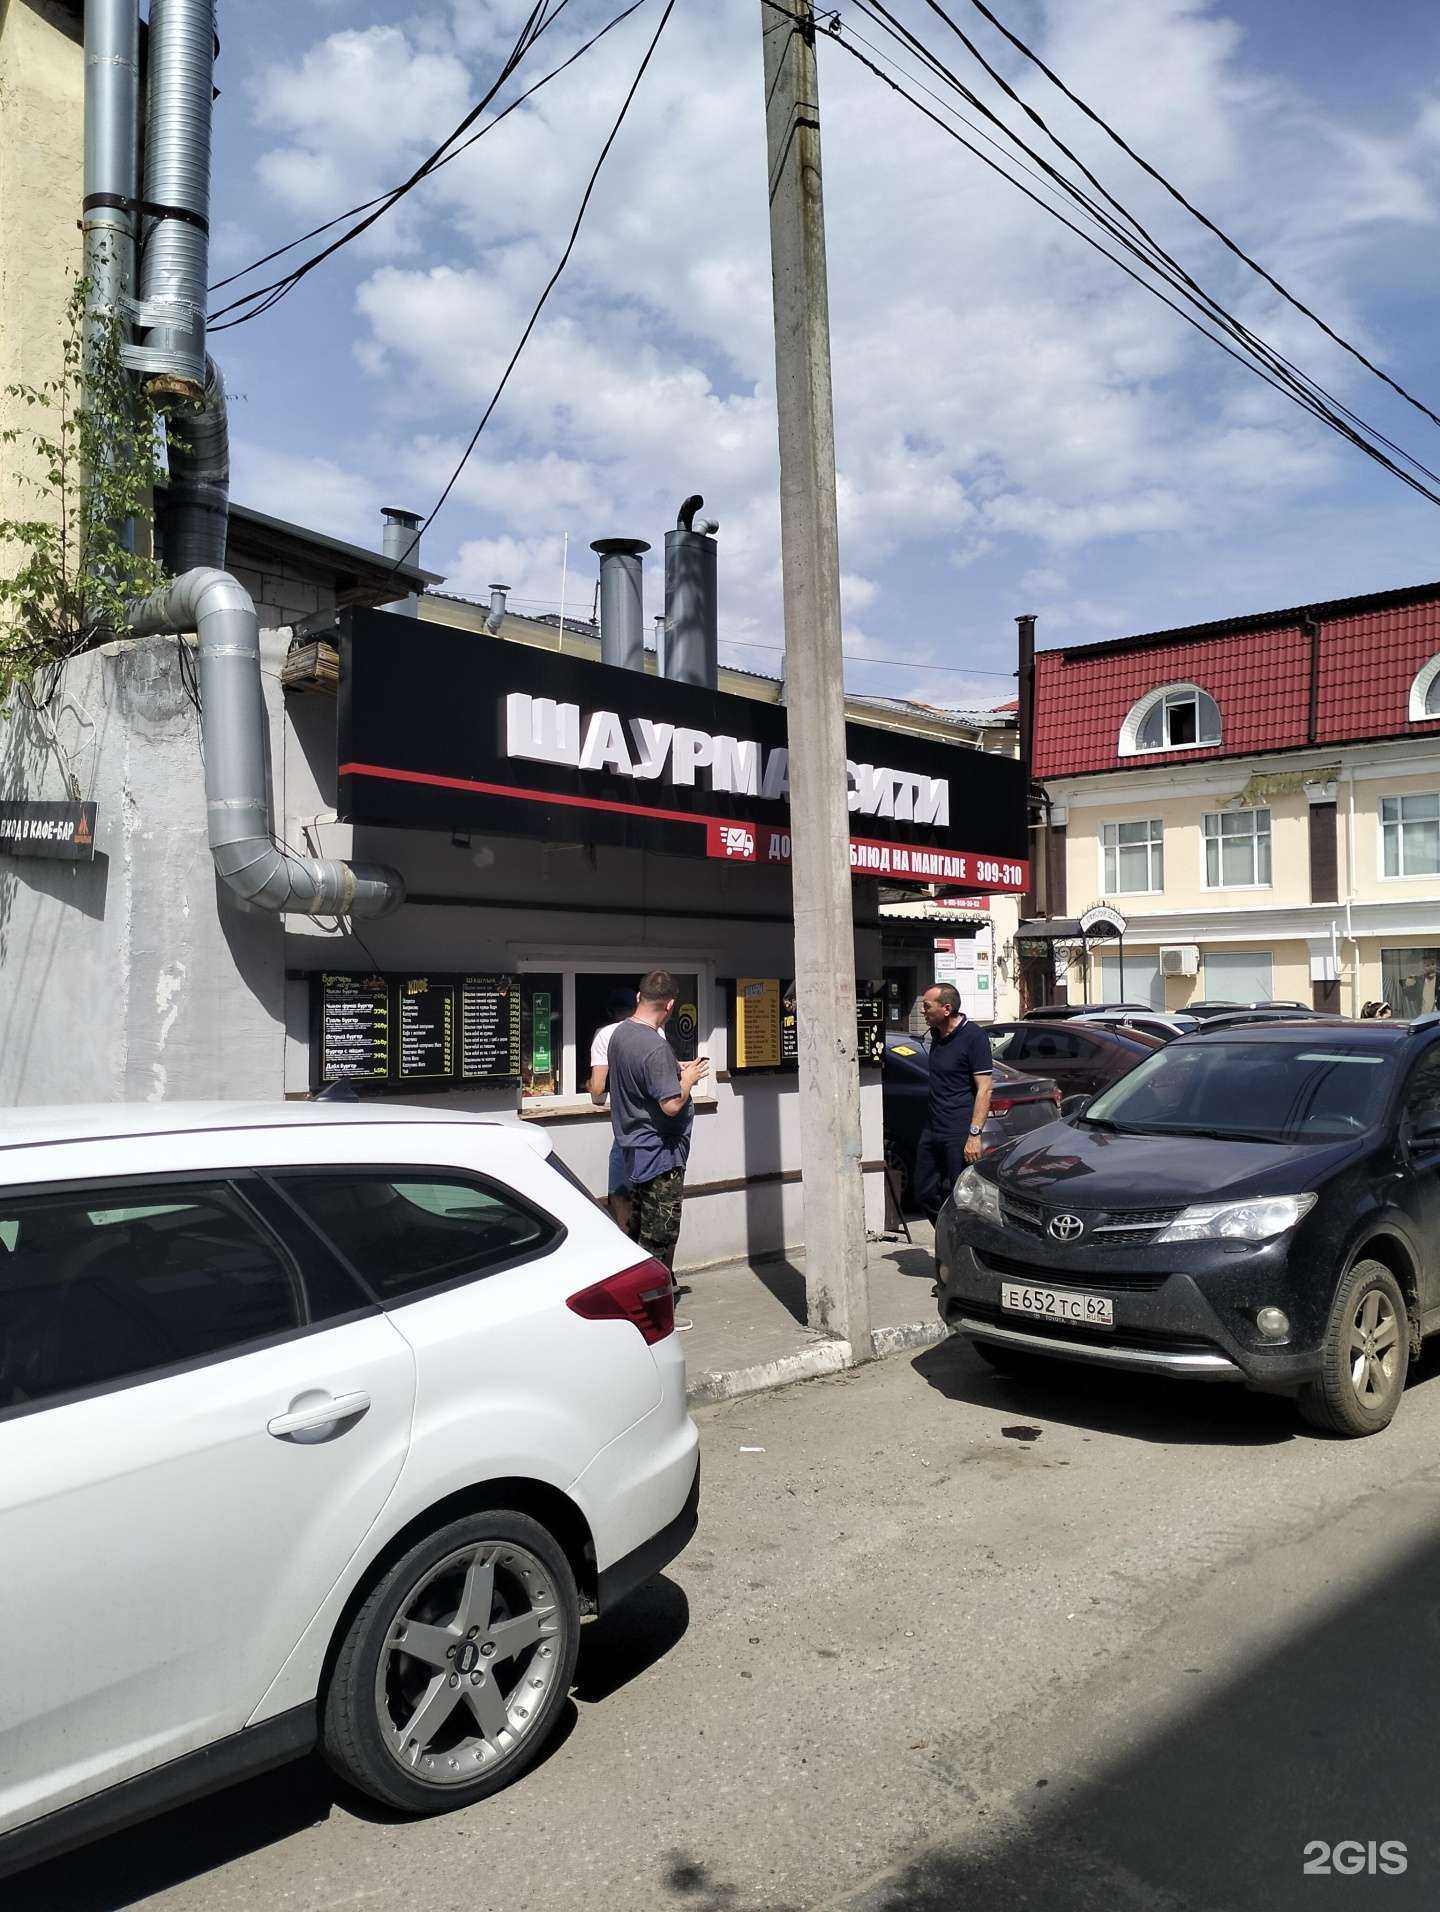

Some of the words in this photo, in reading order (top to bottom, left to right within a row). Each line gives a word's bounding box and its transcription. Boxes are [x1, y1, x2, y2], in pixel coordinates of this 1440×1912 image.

[30, 820, 75, 840] КАФЕ-БАР
[849, 843, 890, 872] БЛЮД
[892, 849, 910, 871] НА
[911, 852, 967, 879] МАНГАЛЕ
[976, 860, 1022, 885] 309-310
[1087, 1298, 1105, 1316] 62
